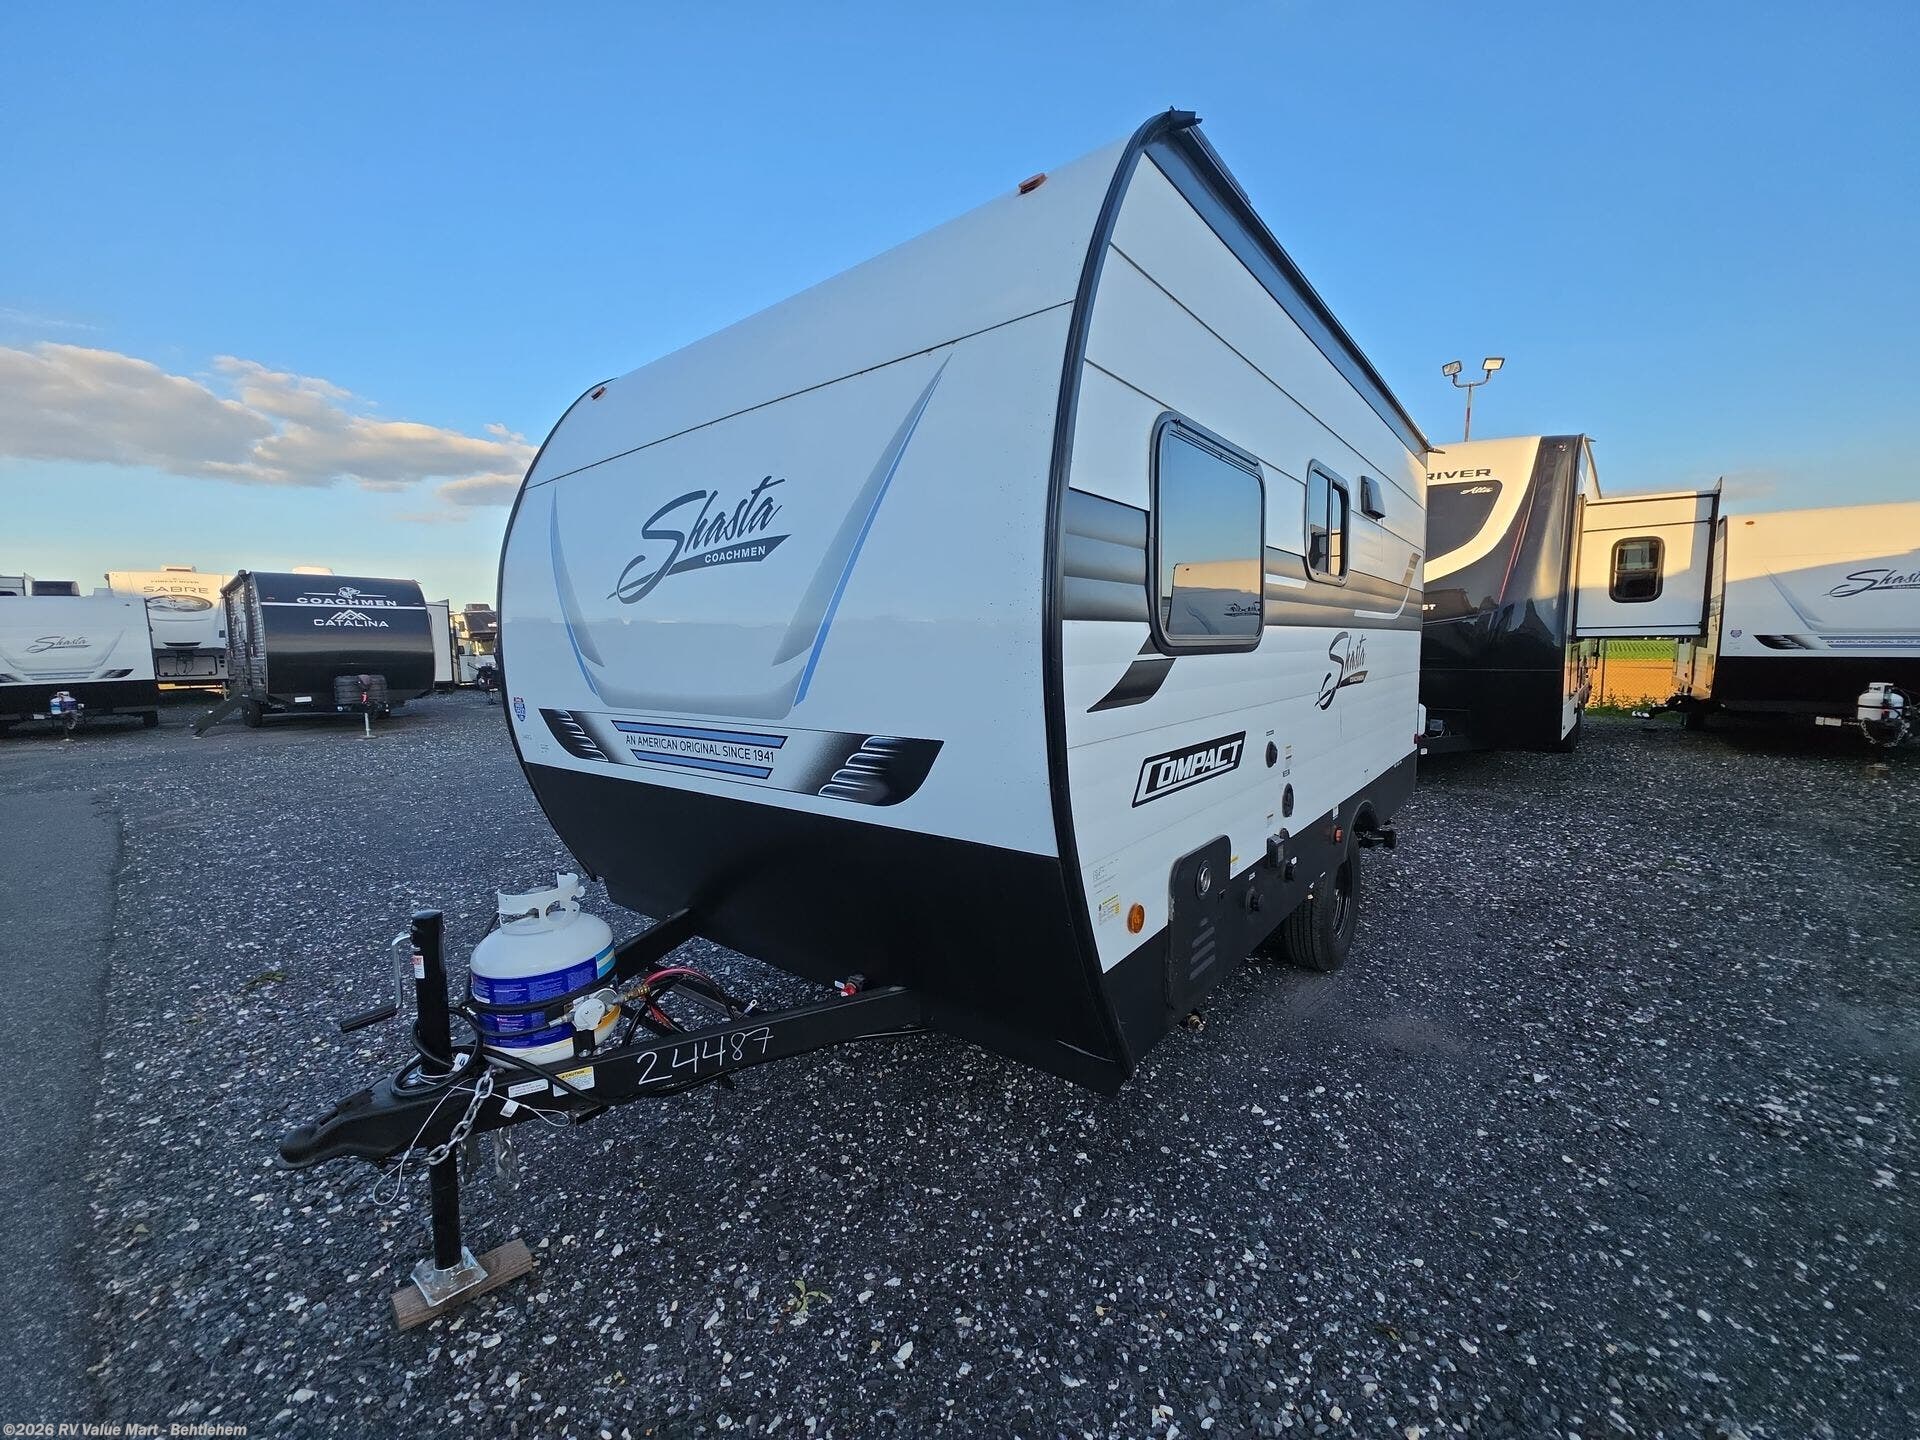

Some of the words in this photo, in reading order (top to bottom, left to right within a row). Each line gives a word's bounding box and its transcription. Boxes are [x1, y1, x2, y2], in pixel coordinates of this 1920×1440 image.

[1427, 468, 1491, 480] RIVER
[616, 475, 786, 605] Shasta
[704, 545, 766, 564] COACHMEN
[143, 585, 209, 594] SABRE
[296, 597, 397, 607] COACHMEN
[313, 618, 389, 628] CATALINA
[26, 635, 89, 654] Shasta
[1318, 631, 1367, 711] Shasta
[625, 734, 636, 746] AN
[637, 736, 678, 751] AMERICAN
[679, 741, 721, 757] ORIGINAL
[722, 746, 751, 760] SINCE
[753, 749, 775, 763] 1941
[1134, 740, 1243, 803] COMPACT
[636, 1026, 775, 1086] 24487
